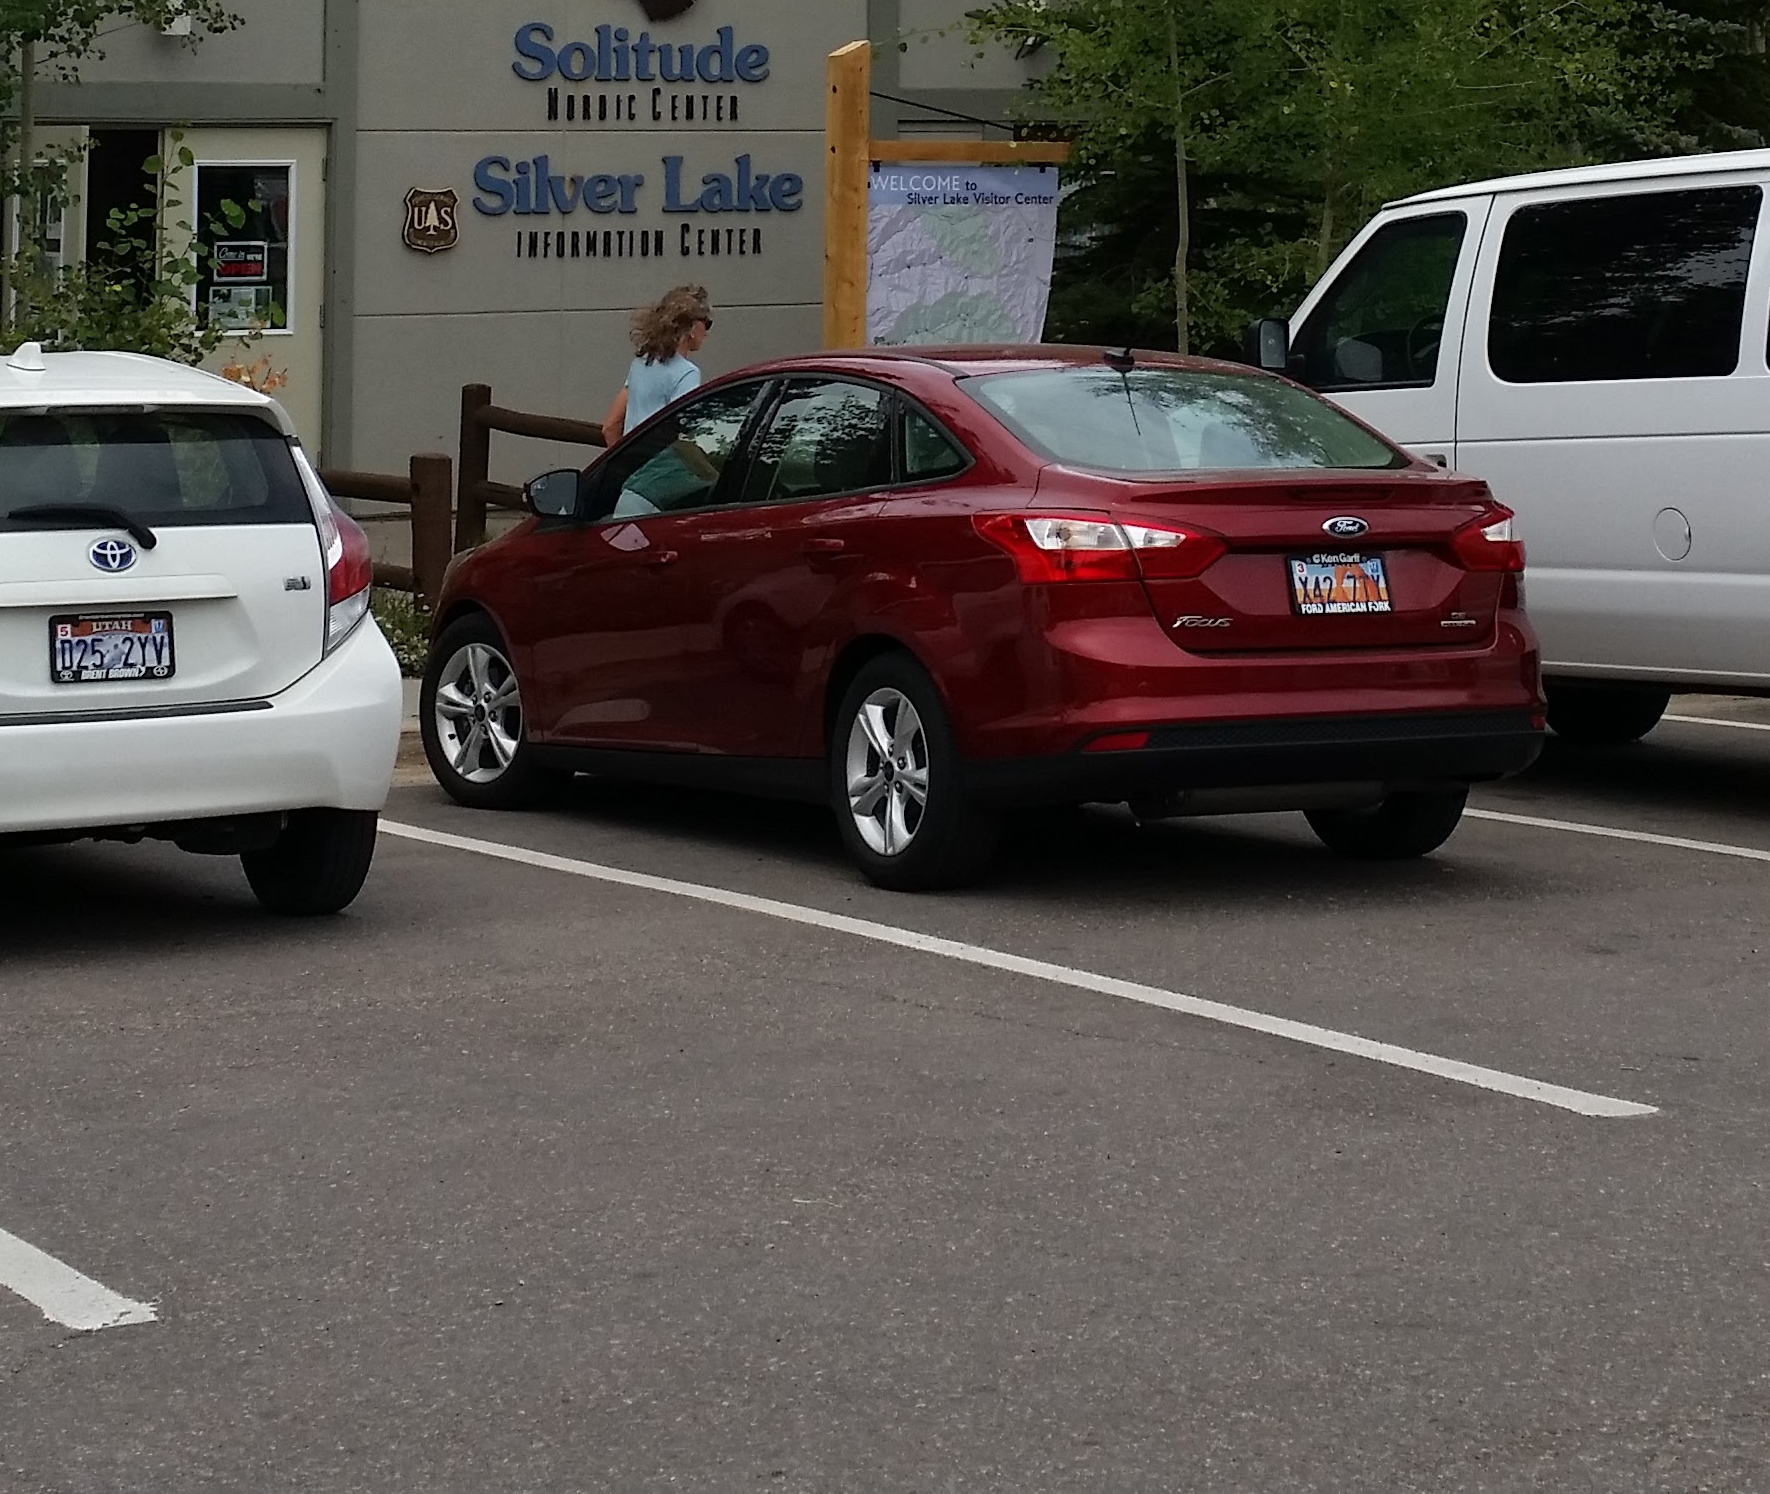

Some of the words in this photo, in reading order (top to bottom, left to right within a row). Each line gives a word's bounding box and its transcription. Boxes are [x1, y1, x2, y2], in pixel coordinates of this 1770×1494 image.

[512, 22, 770, 83] Solitude
[547, 87, 636, 121] NORDIC
[652, 87, 739, 121] CENTER
[472, 155, 644, 215] Silver
[662, 153, 804, 213] Lake
[870, 175, 960, 191] WELCOME
[965, 180, 977, 191] to
[907, 192, 940, 205] Silver
[943, 192, 969, 205] Lake
[974, 192, 1011, 205] Visitor
[1015, 192, 1054, 205] Center
[516, 229, 664, 257] INFORMATION
[680, 223, 762, 256] CENTER
[1335, 520, 1360, 533] Ford
[1321, 553, 1339, 563] Ken
[1301, 603, 1324, 614] FORD
[1325, 601, 1367, 613] AMERICAN
[1368, 600, 1392, 612] FORK
[91, 620, 133, 632] UTAH
[1172, 615, 1234, 628] Focus
[60, 626, 68, 637] 5
[60, 637, 104, 670] D25
[121, 635, 165, 667] 2YV
[80, 668, 107, 680] BRENT
[108, 666, 138, 679] BROWN
